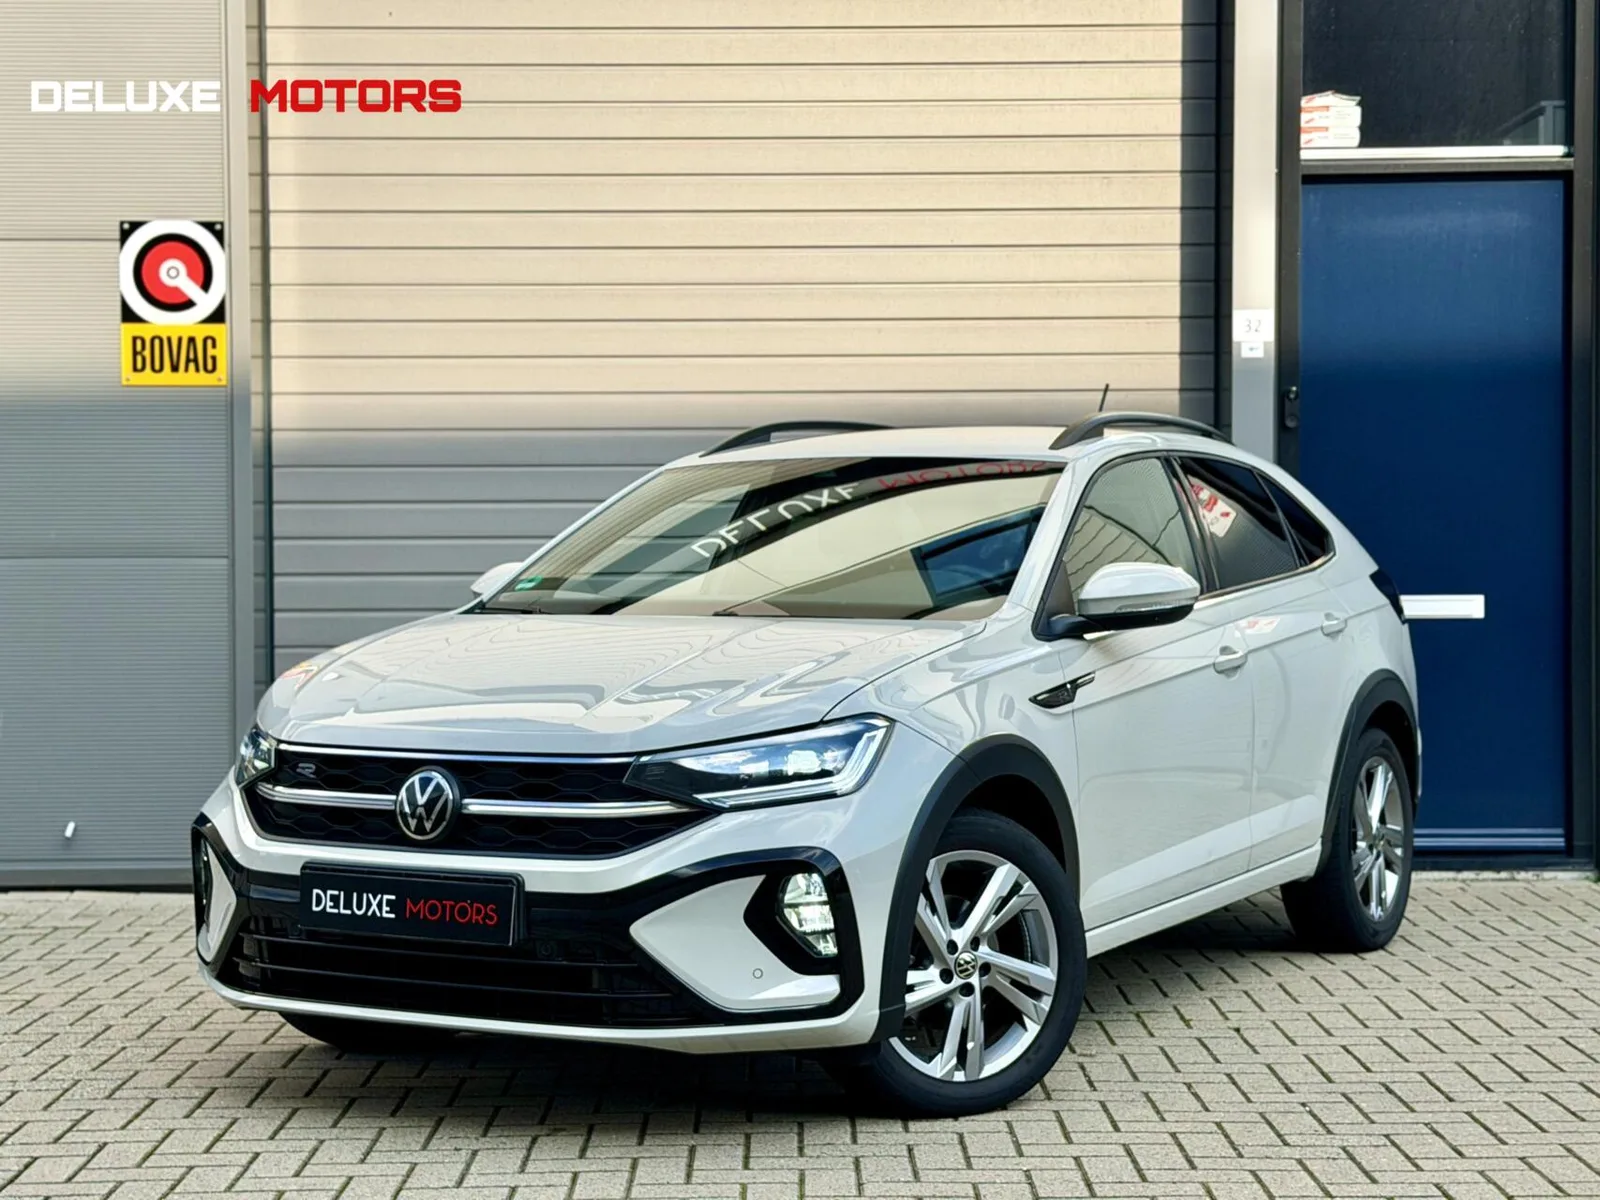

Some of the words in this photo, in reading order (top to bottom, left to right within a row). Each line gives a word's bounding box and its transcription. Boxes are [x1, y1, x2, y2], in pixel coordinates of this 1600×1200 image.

[1244, 317, 1261, 333] 32
[131, 335, 218, 374] BOVAG
[311, 888, 396, 918] DELUXE
[406, 899, 498, 925] MOTORS
